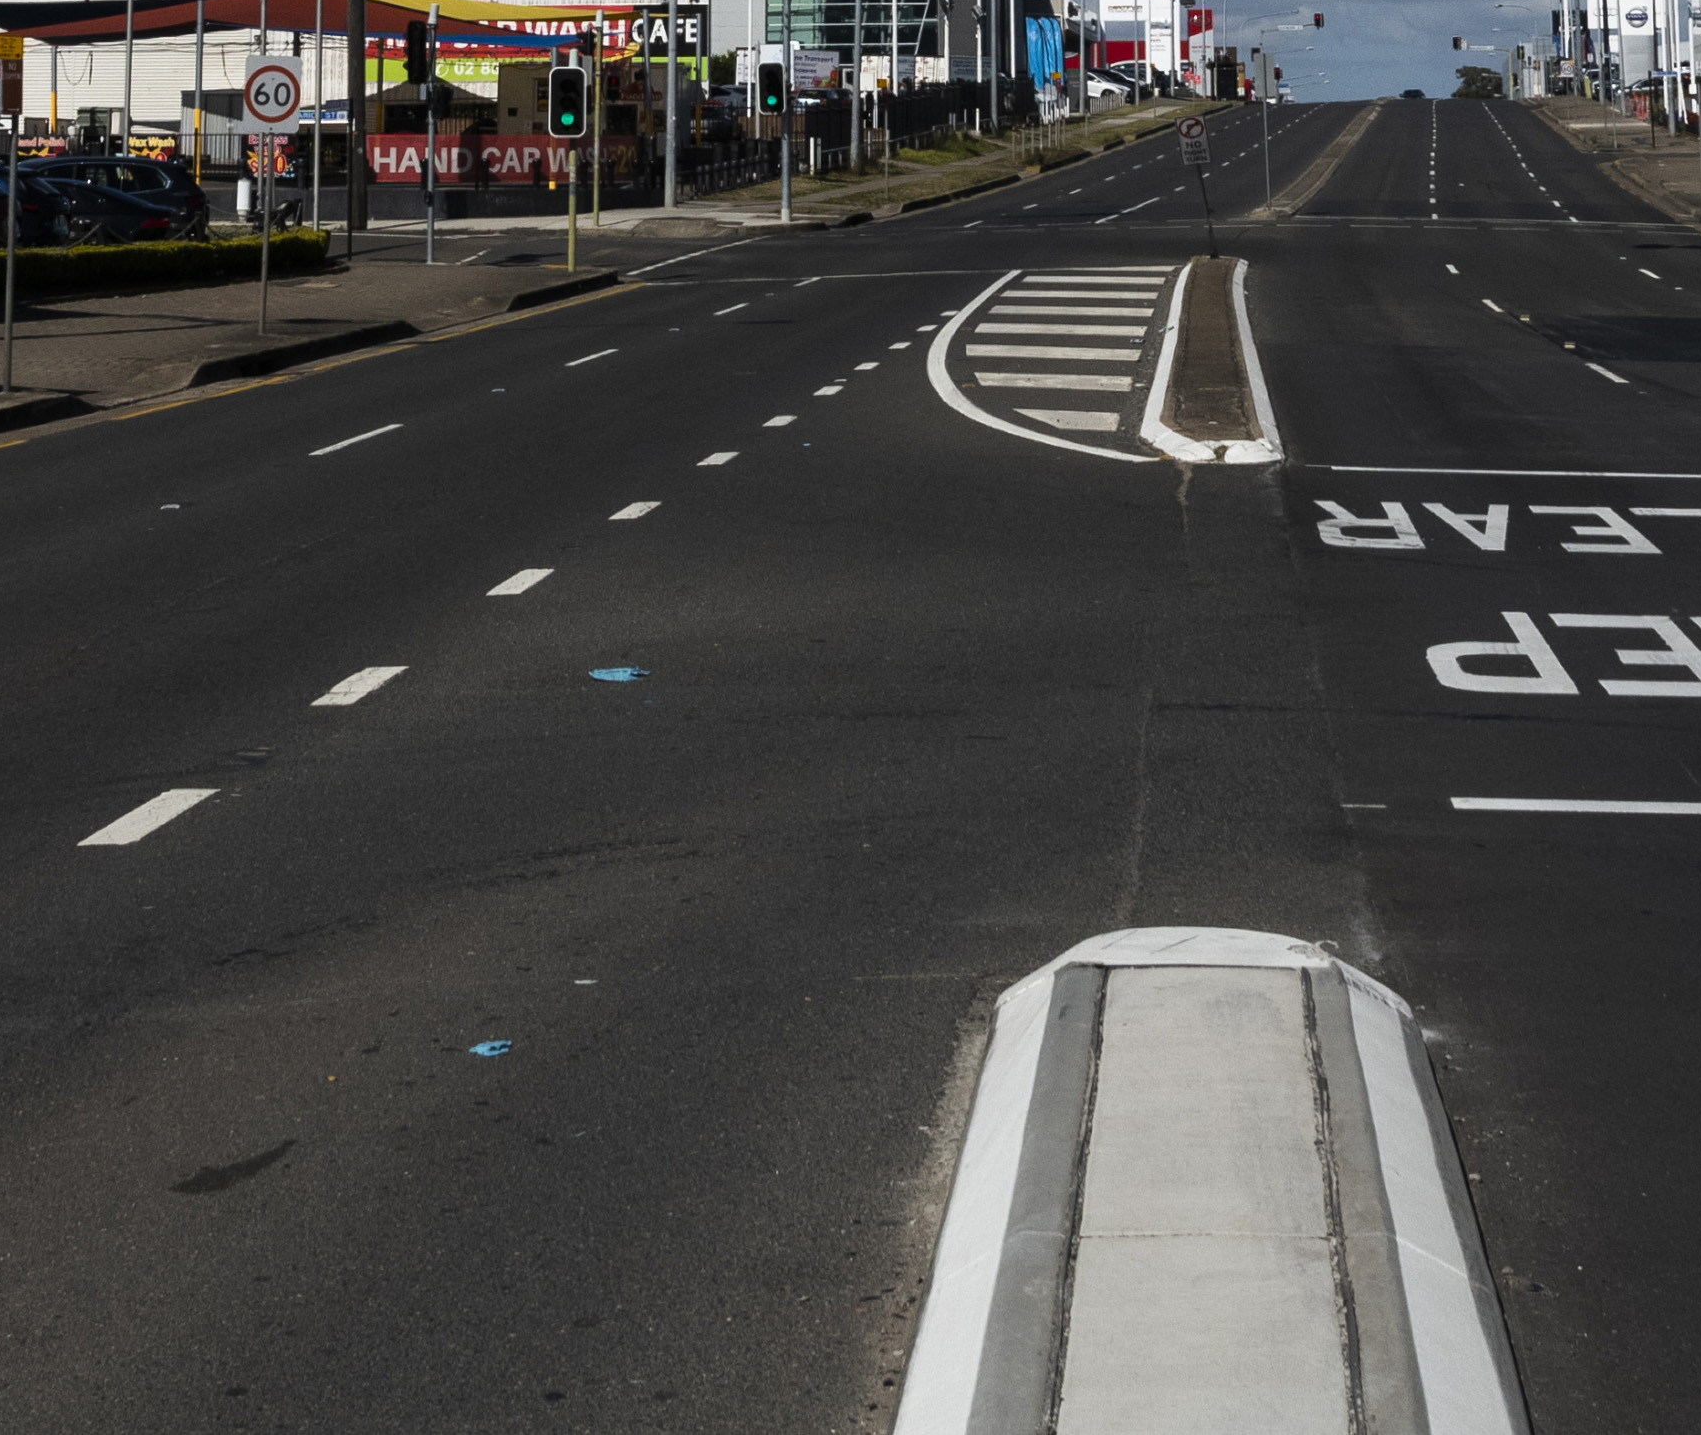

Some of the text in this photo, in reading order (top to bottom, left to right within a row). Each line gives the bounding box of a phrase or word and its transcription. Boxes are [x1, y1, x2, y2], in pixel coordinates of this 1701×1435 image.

[804, 55, 834, 64] Transport
[454, 62, 474, 75] 02
[254, 82, 291, 106] 60
[17, 136, 66, 147] and Polish
[147, 137, 176, 147] Wash
[1185, 140, 1201, 149] NO
[373, 146, 473, 173] HAND
[482, 146, 541, 173] CAR
